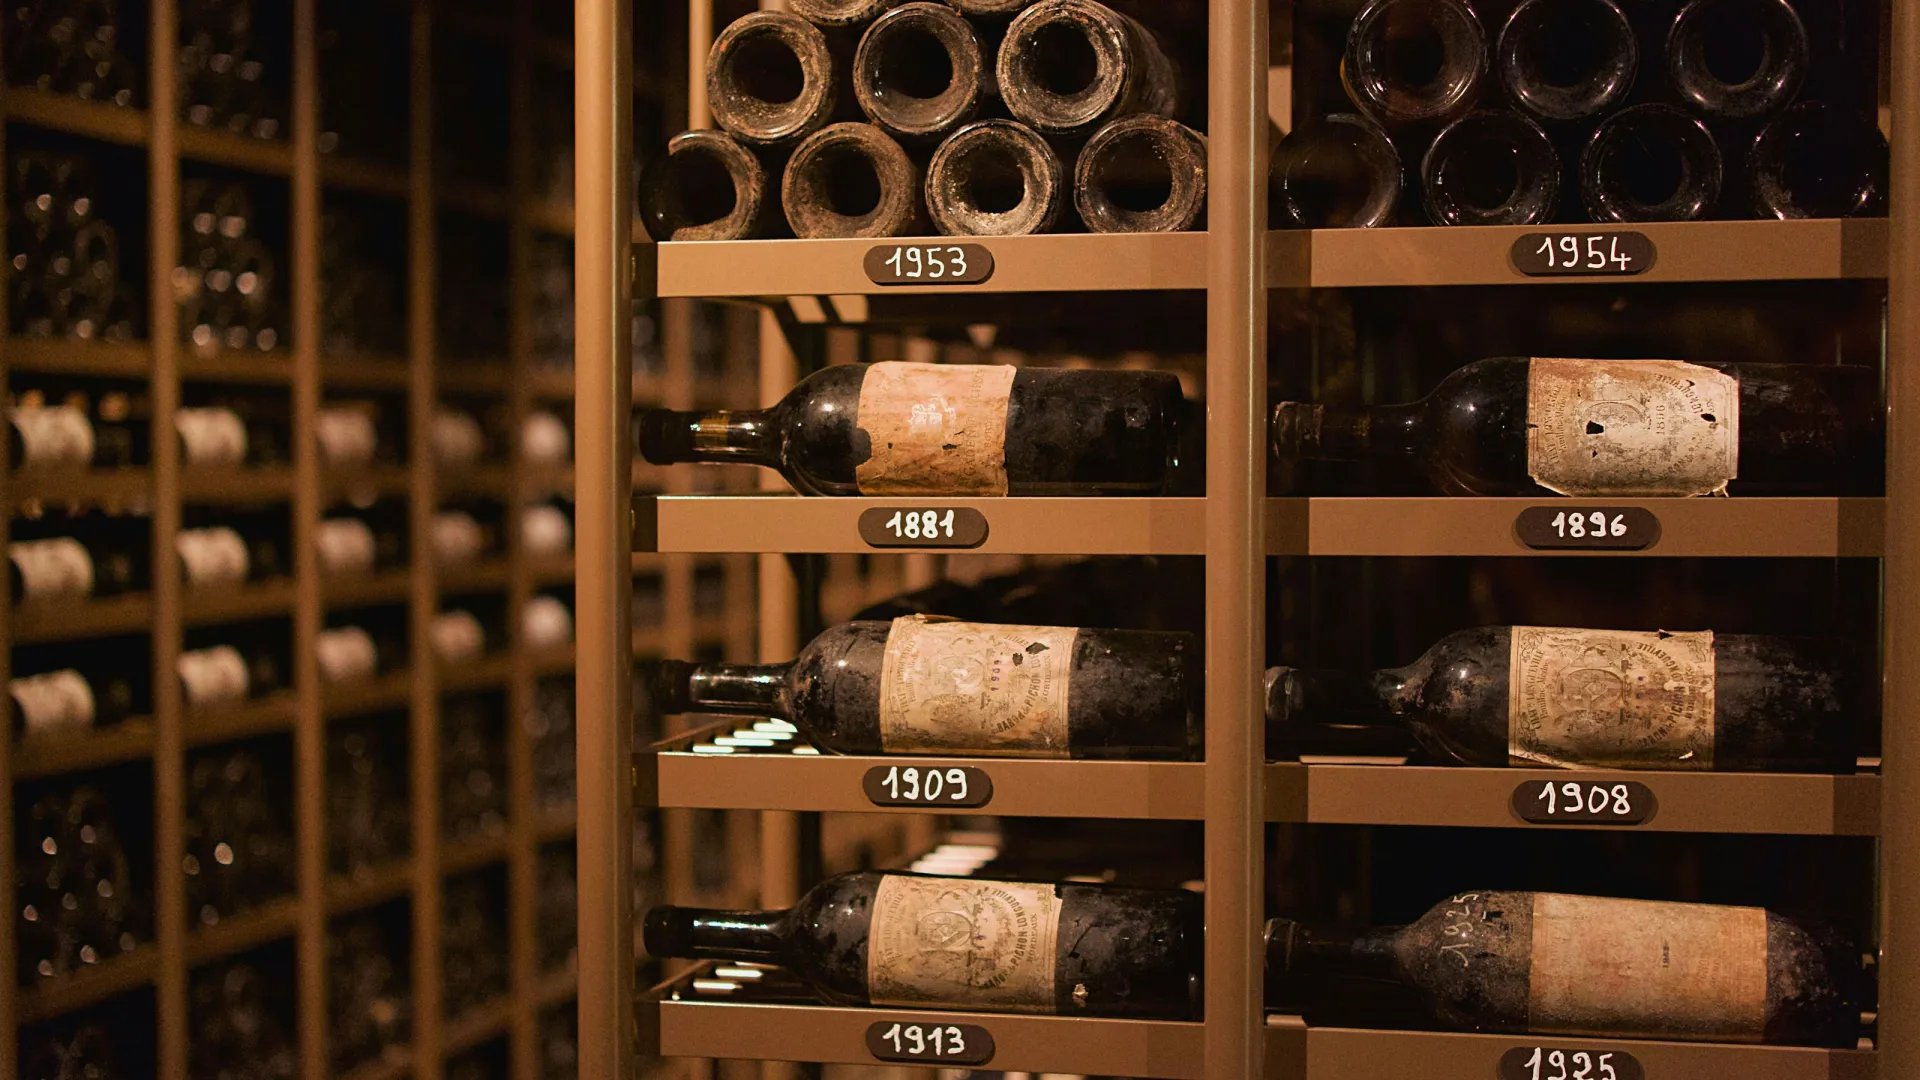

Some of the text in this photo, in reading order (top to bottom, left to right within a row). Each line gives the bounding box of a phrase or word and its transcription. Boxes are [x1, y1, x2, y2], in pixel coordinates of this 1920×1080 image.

[886, 247, 966, 277] 1953
[1537, 236, 1632, 270] 1954
[886, 510, 954, 538] 1881
[1552, 511, 1626, 538] 1896
[991, 660, 1001, 691] 1909
[1024, 674, 1041, 707] PICHON
[882, 767, 967, 800] 1909
[1539, 782, 1630, 815] 1908
[1027, 913, 1038, 963] BORDEAUX
[1441, 893, 1479, 967] 1925
[883, 1024, 964, 1056] 1913
[1525, 1047, 1616, 1080] 1925
